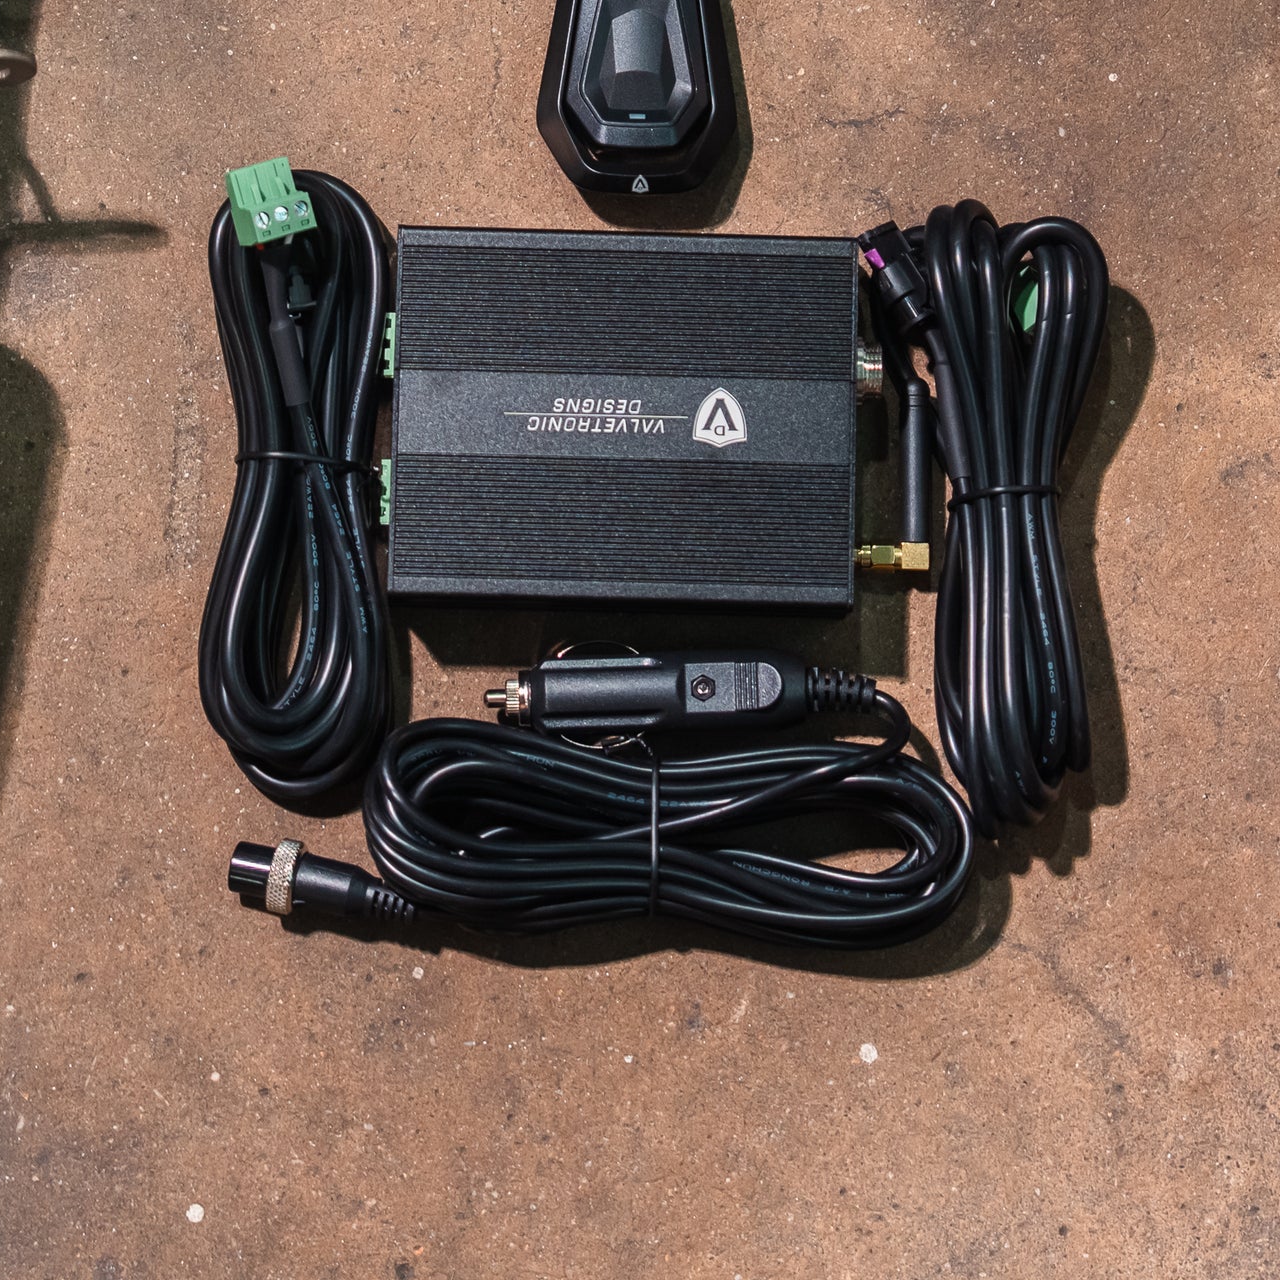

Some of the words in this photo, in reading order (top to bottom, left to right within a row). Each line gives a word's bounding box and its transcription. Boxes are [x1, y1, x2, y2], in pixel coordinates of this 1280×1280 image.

[552, 397, 642, 413] DESIGNS
[526, 416, 665, 434] VALVETRONIC
[1026, 512, 1035, 540] AWM
[310, 534, 319, 567] 300V
[345, 551, 361, 593] STYLE
[1031, 554, 1043, 597] STYLE
[306, 627, 317, 662] 2464
[1039, 612, 1051, 646] 2464
[280, 675, 306, 709] TYLE
[1047, 661, 1057, 694] 80°C
[1048, 710, 1058, 745] 300V
[731, 859, 811, 888] RONGCHUN
